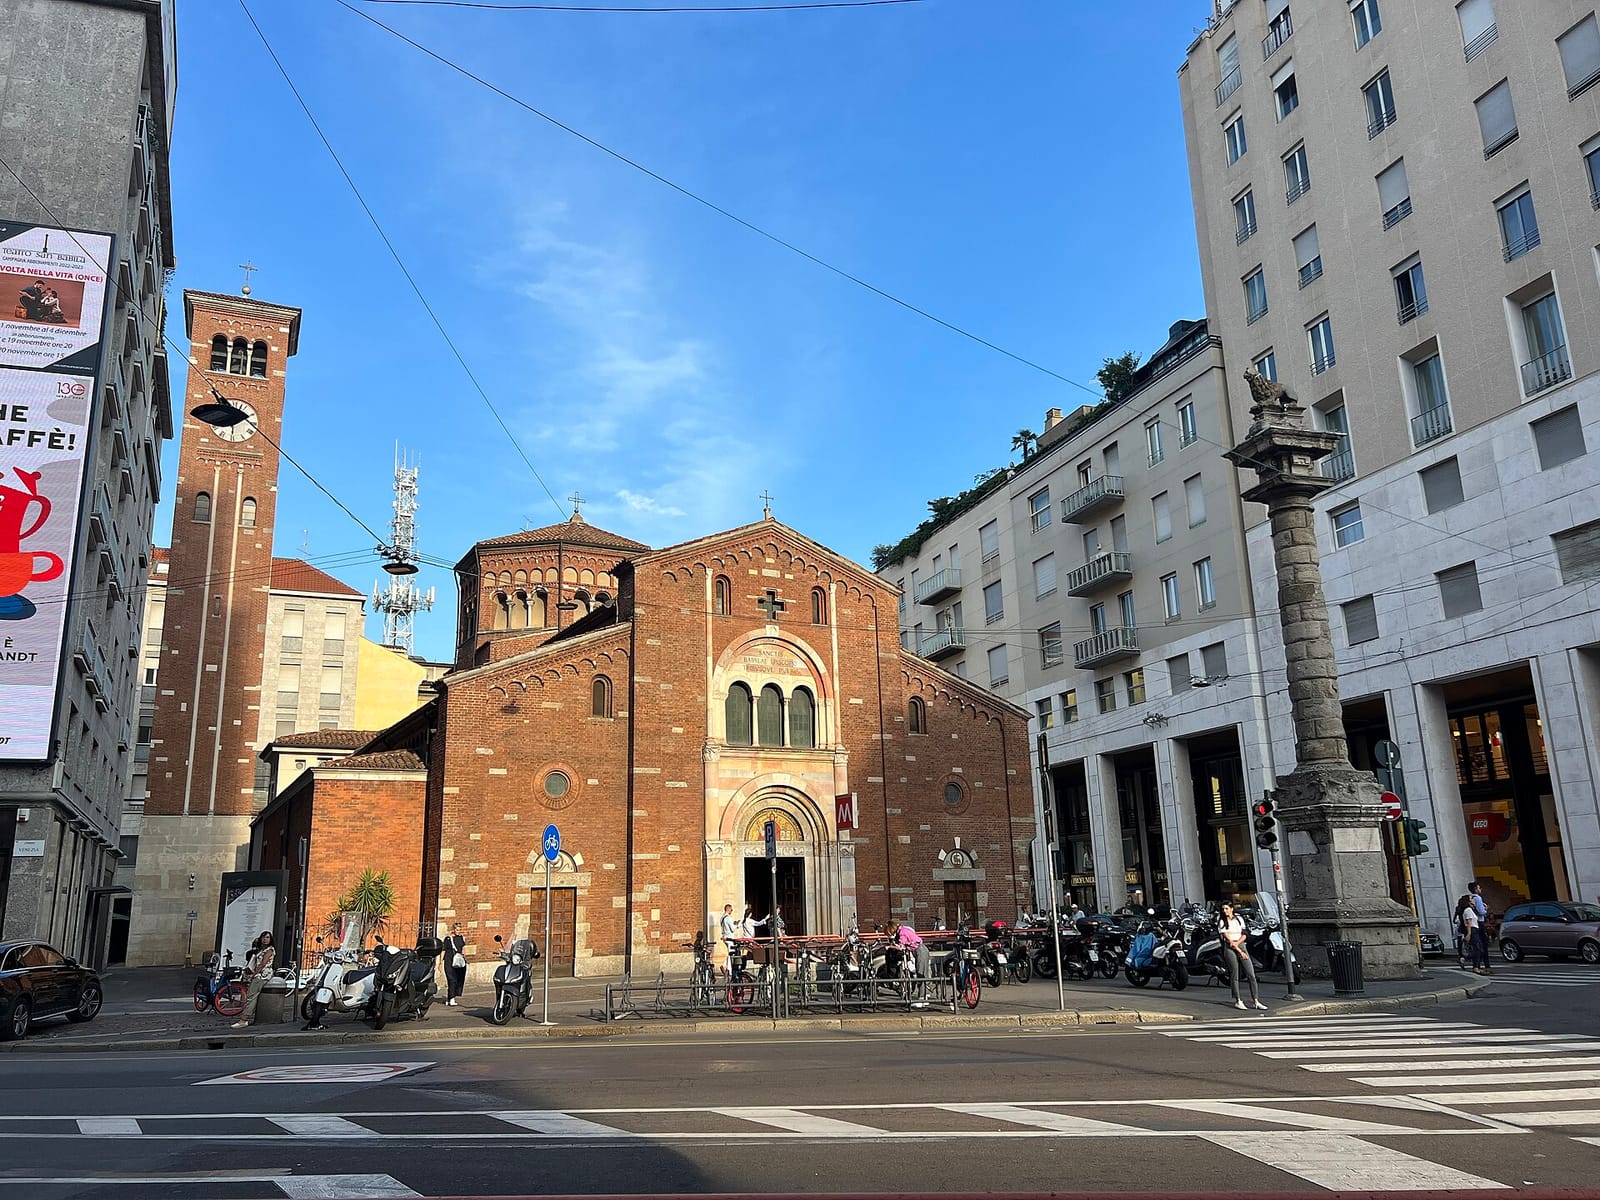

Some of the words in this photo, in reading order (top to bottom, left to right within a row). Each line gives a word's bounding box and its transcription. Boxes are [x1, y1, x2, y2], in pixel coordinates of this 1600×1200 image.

[0, 264, 26, 274] VOLTA
[27, 268, 54, 277] NELLA
[55, 271, 74, 280] VITA
[75, 274, 104, 283] (ONCE)
[5, 323, 41, 332] novembre
[54, 328, 87, 337] dicembre
[16, 338, 52, 347] novembre
[7, 347, 43, 357] novembre
[0, 427, 76, 451] FFÈ!
[5, 635, 14, 648] È
[838, 803, 852, 823] M
[1473, 820, 1488, 828] LEGO
